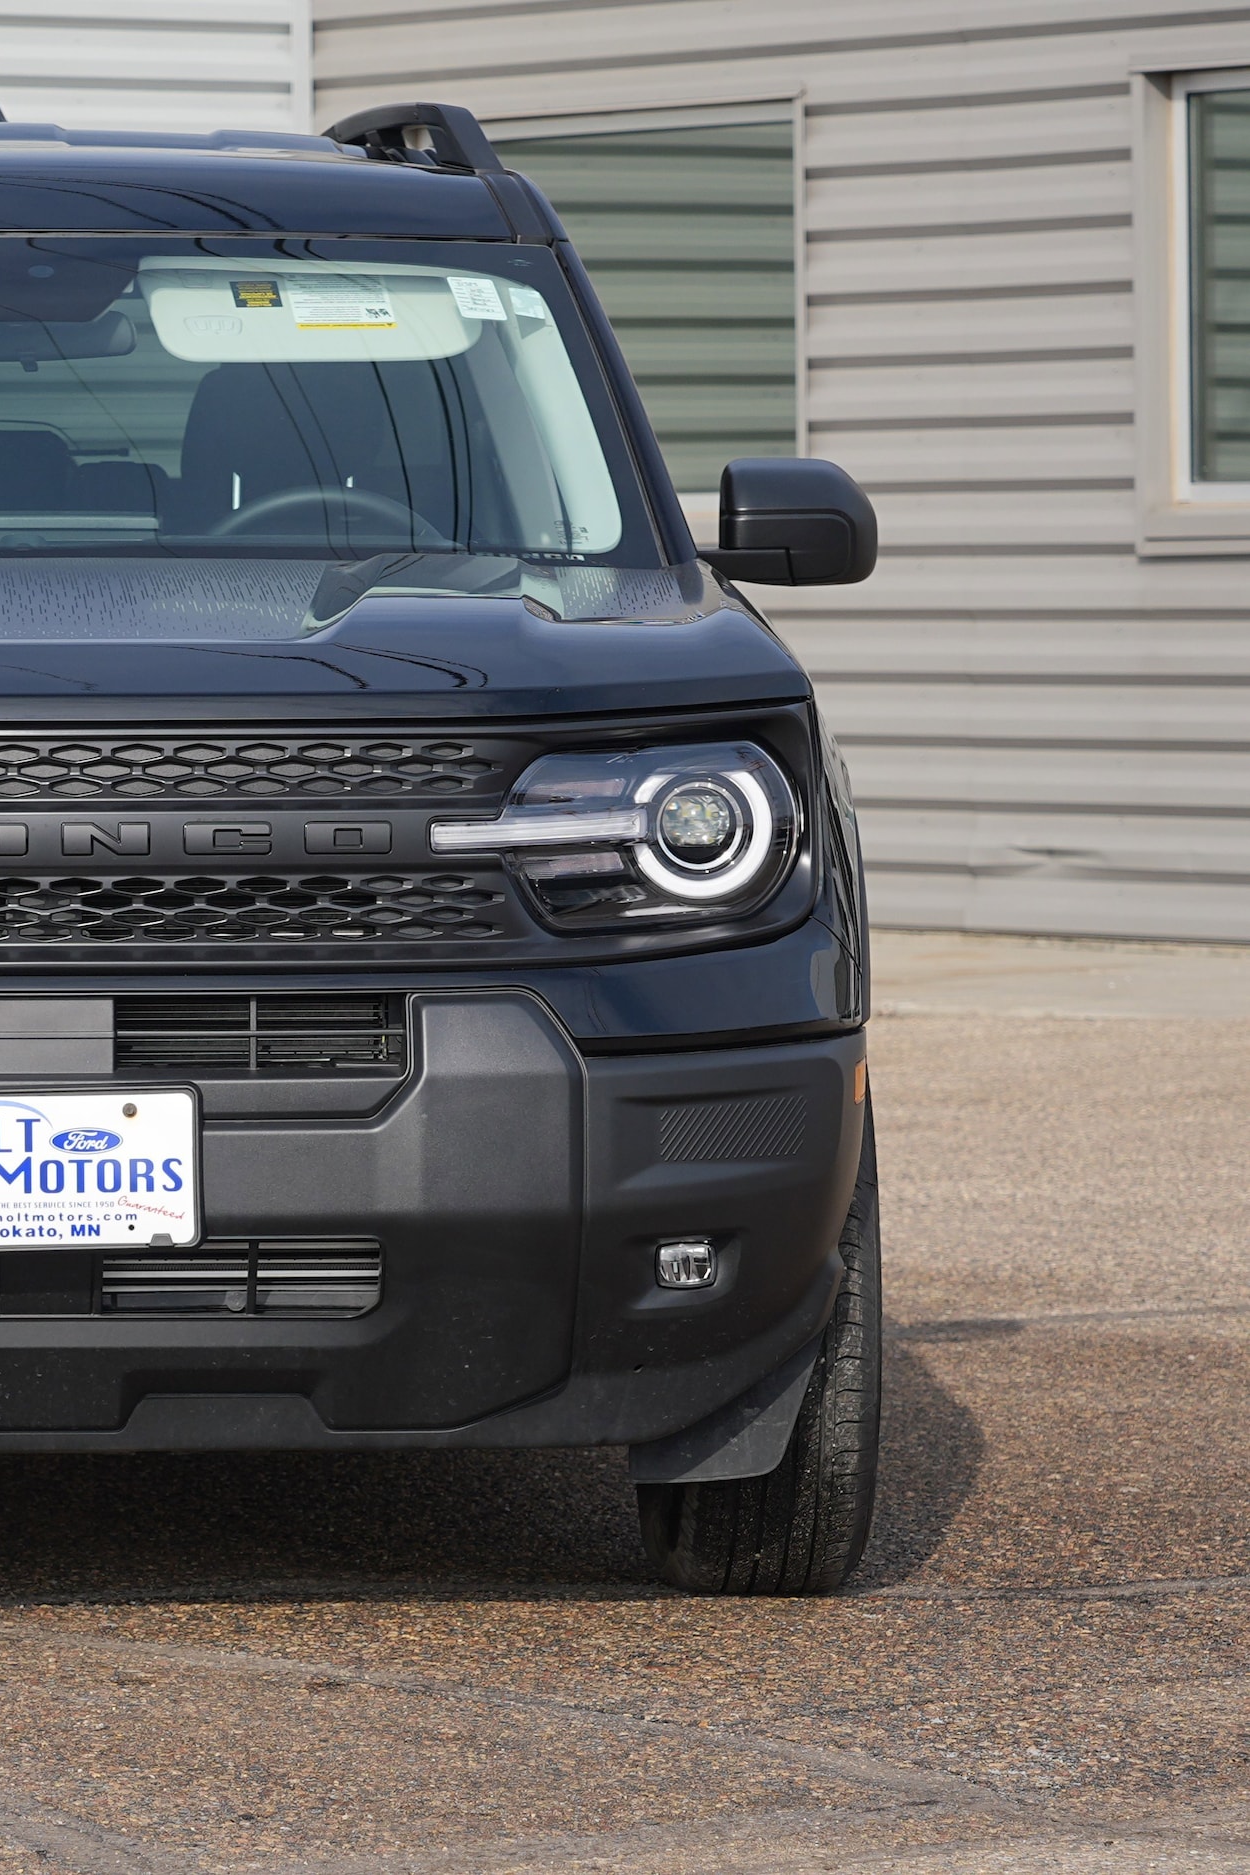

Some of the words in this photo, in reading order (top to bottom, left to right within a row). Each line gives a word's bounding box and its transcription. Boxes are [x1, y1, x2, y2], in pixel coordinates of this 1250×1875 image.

[63, 1130, 110, 1151] Ford
[117, 1195, 186, 1220] Guaranteed
[70, 1223, 101, 1237] MN
